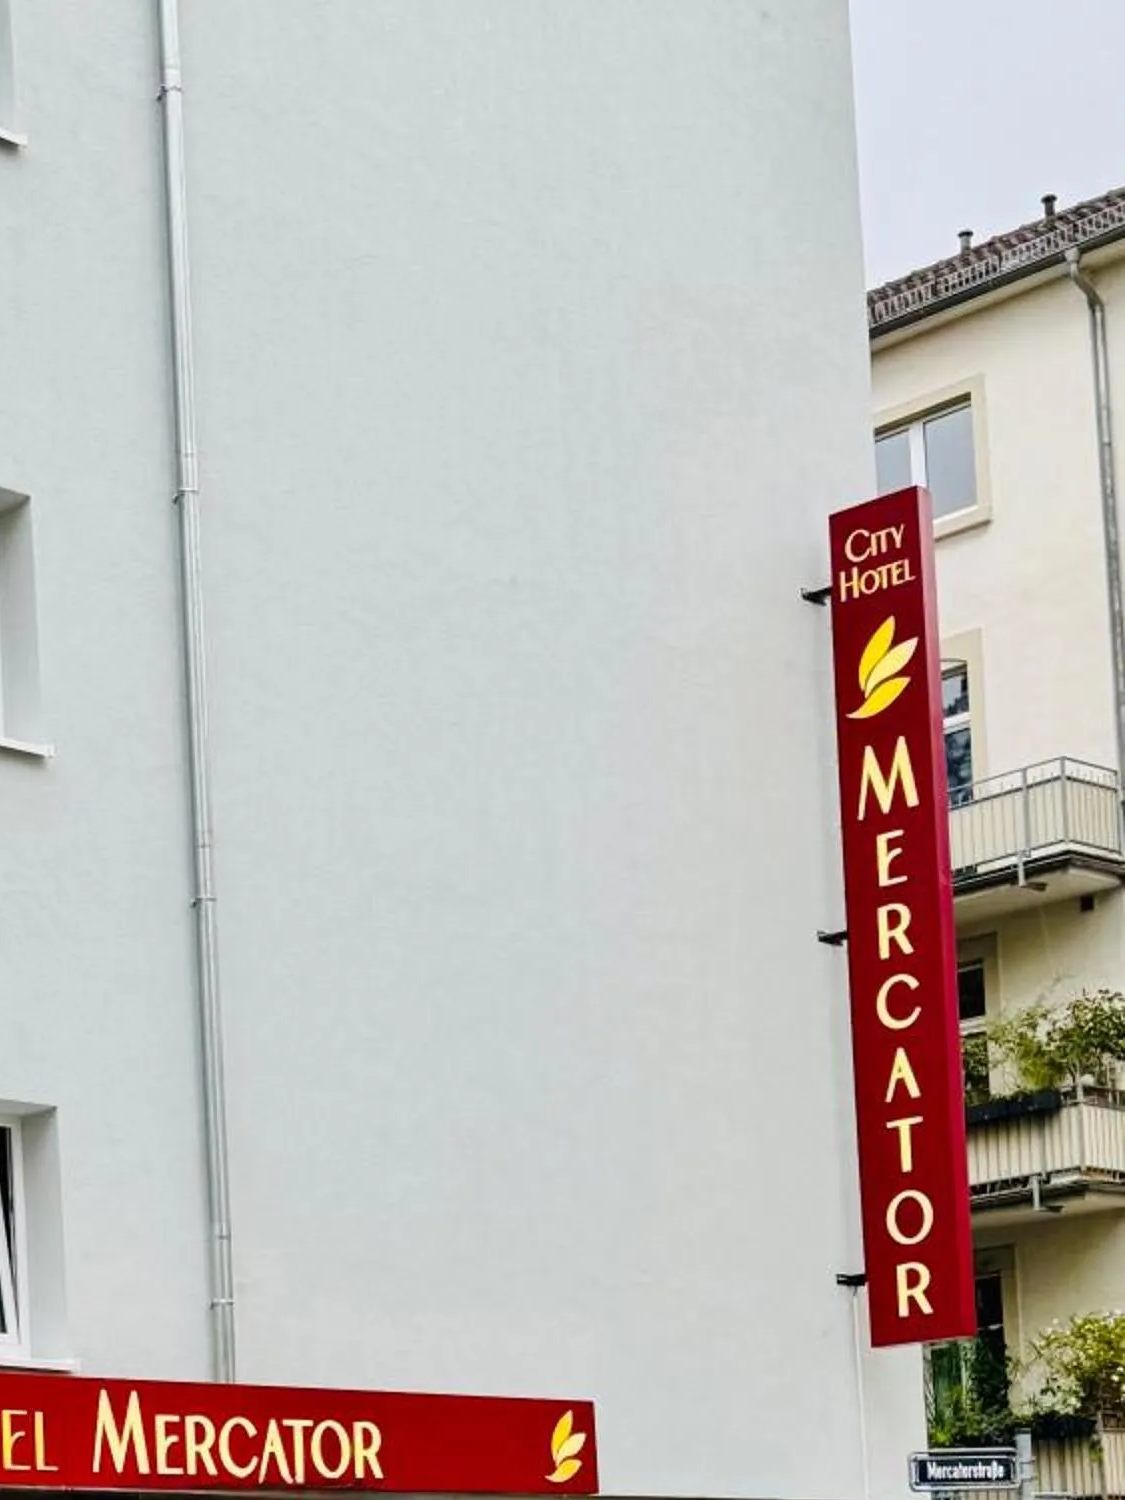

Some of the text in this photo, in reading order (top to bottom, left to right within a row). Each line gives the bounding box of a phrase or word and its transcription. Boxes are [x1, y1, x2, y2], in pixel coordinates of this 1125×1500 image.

[844, 523, 906, 564] CITY
[839, 558, 916, 602] HOTEL
[857, 735, 934, 1318] MERCATOR
[92, 1388, 384, 1485] MERCATOR
